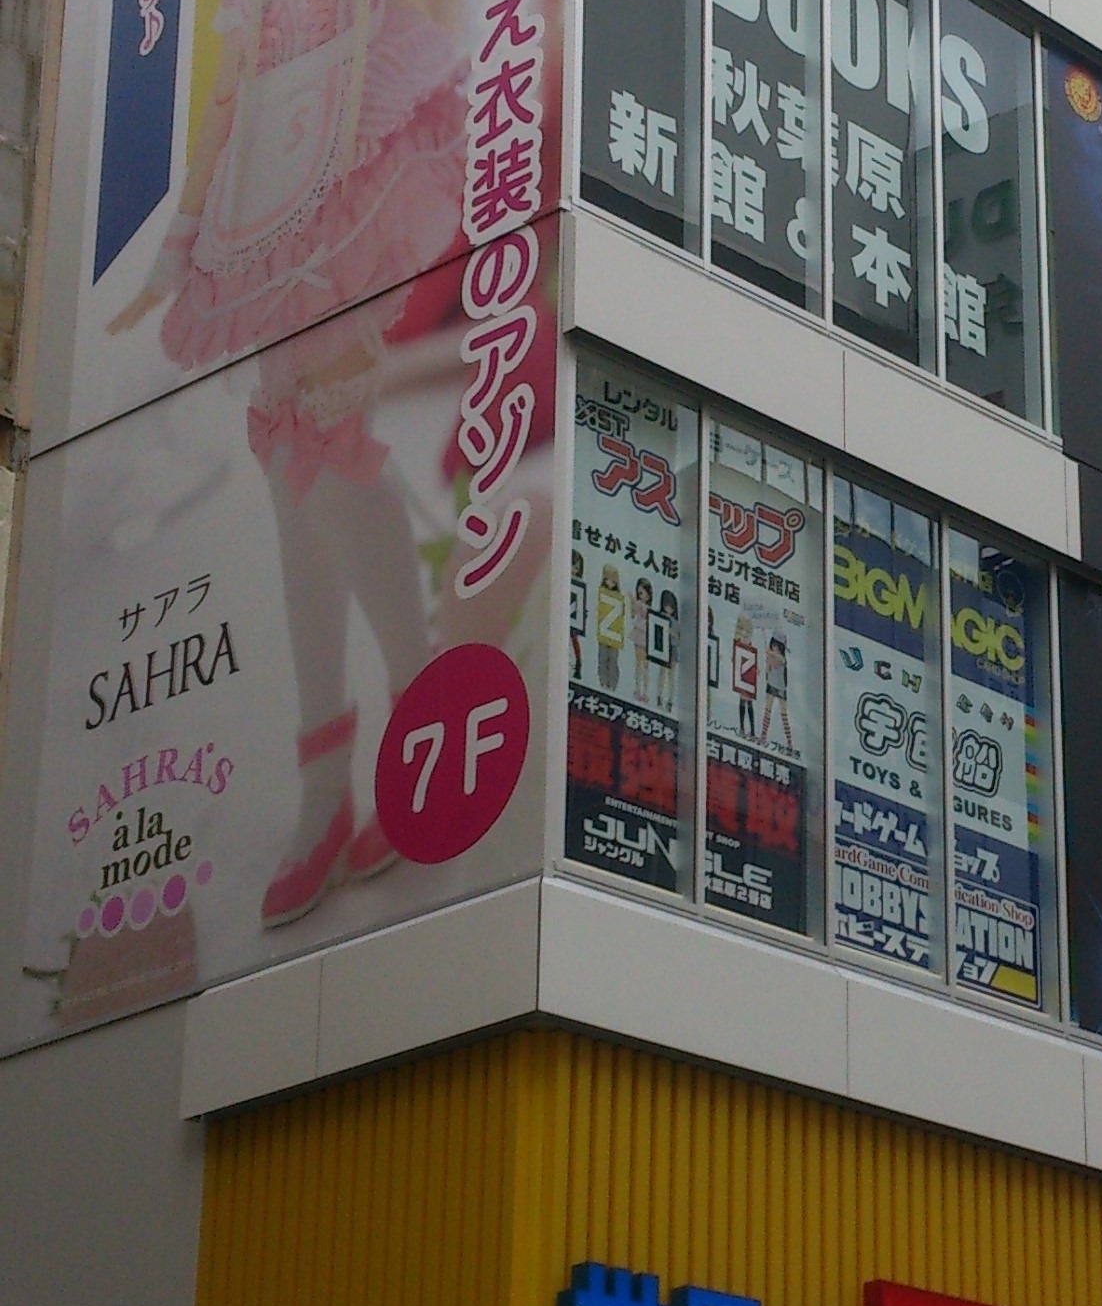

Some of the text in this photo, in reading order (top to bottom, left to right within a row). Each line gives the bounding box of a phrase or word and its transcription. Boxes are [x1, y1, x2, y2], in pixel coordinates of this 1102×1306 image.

[711, 48, 907, 221] 秋葉原
[604, 381, 678, 432] レンタル
[118, 573, 212, 643] サアラ
[85, 621, 240, 730] SAHRA
[403, 697, 508, 814] 7F
[134, 807, 169, 845] la
[850, 755, 1013, 833] TOYS & GURES
[100, 829, 192, 890] mode
[1002, 902, 1034, 931] Shop
